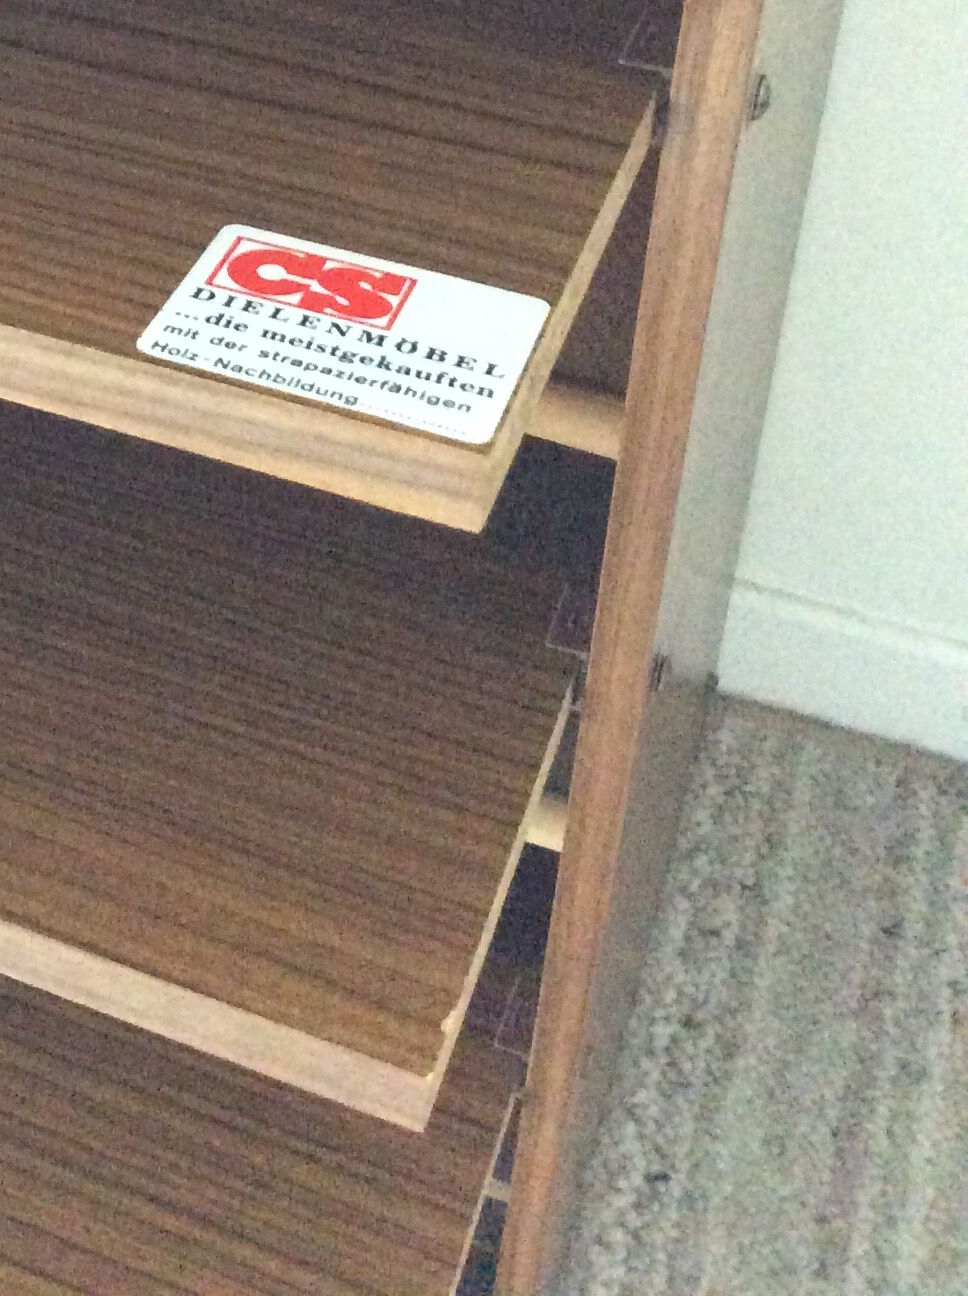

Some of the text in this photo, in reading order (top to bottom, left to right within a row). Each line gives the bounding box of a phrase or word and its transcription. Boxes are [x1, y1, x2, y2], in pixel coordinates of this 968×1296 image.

[227, 248, 402, 321] CS
[163, 323, 472, 413] mit der strapazierfähigen
[189, 286, 506, 379] DIELENMÖBEL
[260, 327, 495, 399] meistgekauften
